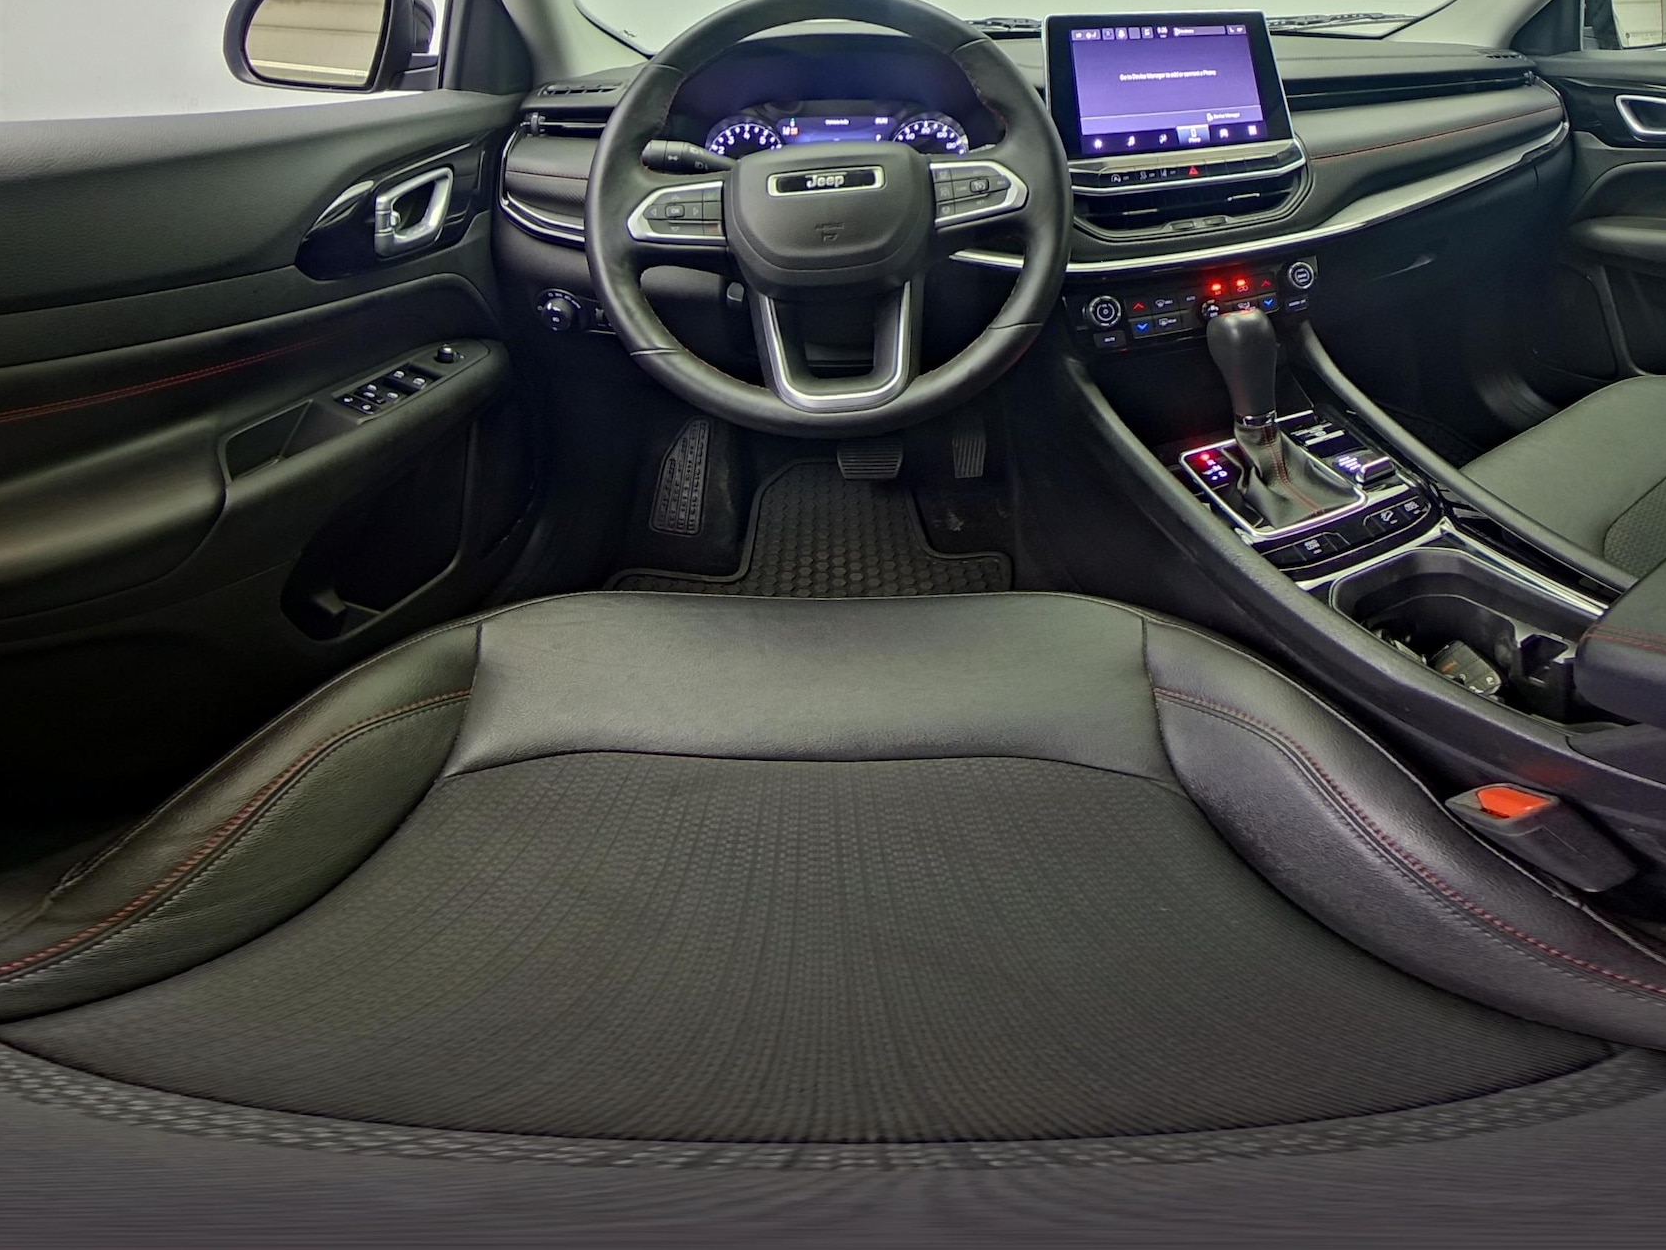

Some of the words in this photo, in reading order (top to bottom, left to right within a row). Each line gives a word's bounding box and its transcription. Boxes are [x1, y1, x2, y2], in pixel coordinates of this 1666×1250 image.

[728, 135, 735, 145] 3
[743, 131, 751, 140] 4
[759, 135, 767, 145] 5
[905, 133, 915, 141] 60
[717, 146, 725, 155] 2
[805, 172, 847, 188] Jeep
